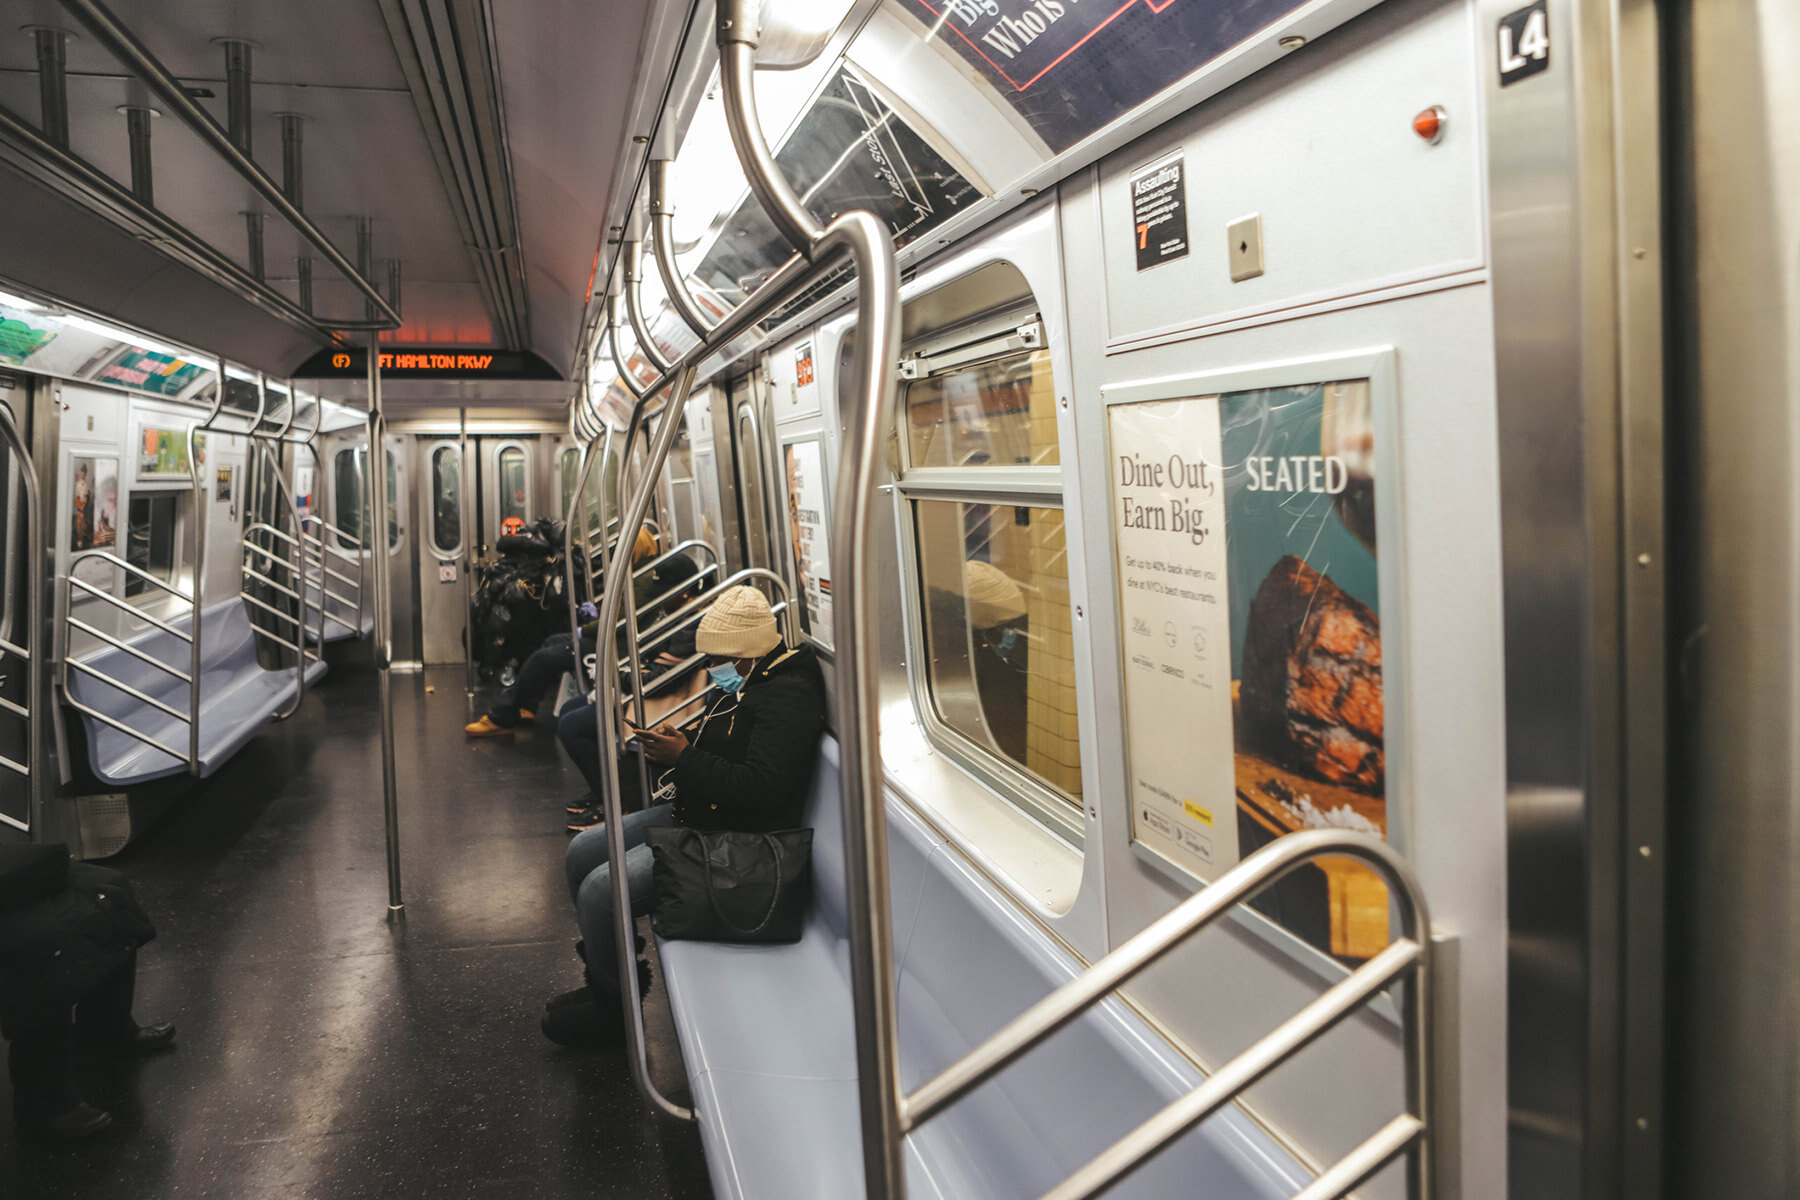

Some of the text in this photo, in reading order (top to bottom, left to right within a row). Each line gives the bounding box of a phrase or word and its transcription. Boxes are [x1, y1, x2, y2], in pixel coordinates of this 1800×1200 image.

[981, 14, 1046, 59] Who
[1499, 9, 1549, 74] L4
[878, 167, 904, 198] Last
[1134, 165, 1180, 197] Assaulting
[1136, 222, 1149, 250] 7
[378, 353, 394, 368] FT
[396, 353, 456, 369] HAMILTON
[457, 355, 493, 369] PKWY
[1119, 453, 1215, 496] Dine Out,
[1245, 455, 1348, 495] SEATED
[1122, 496, 1209, 546] Earn Big.
